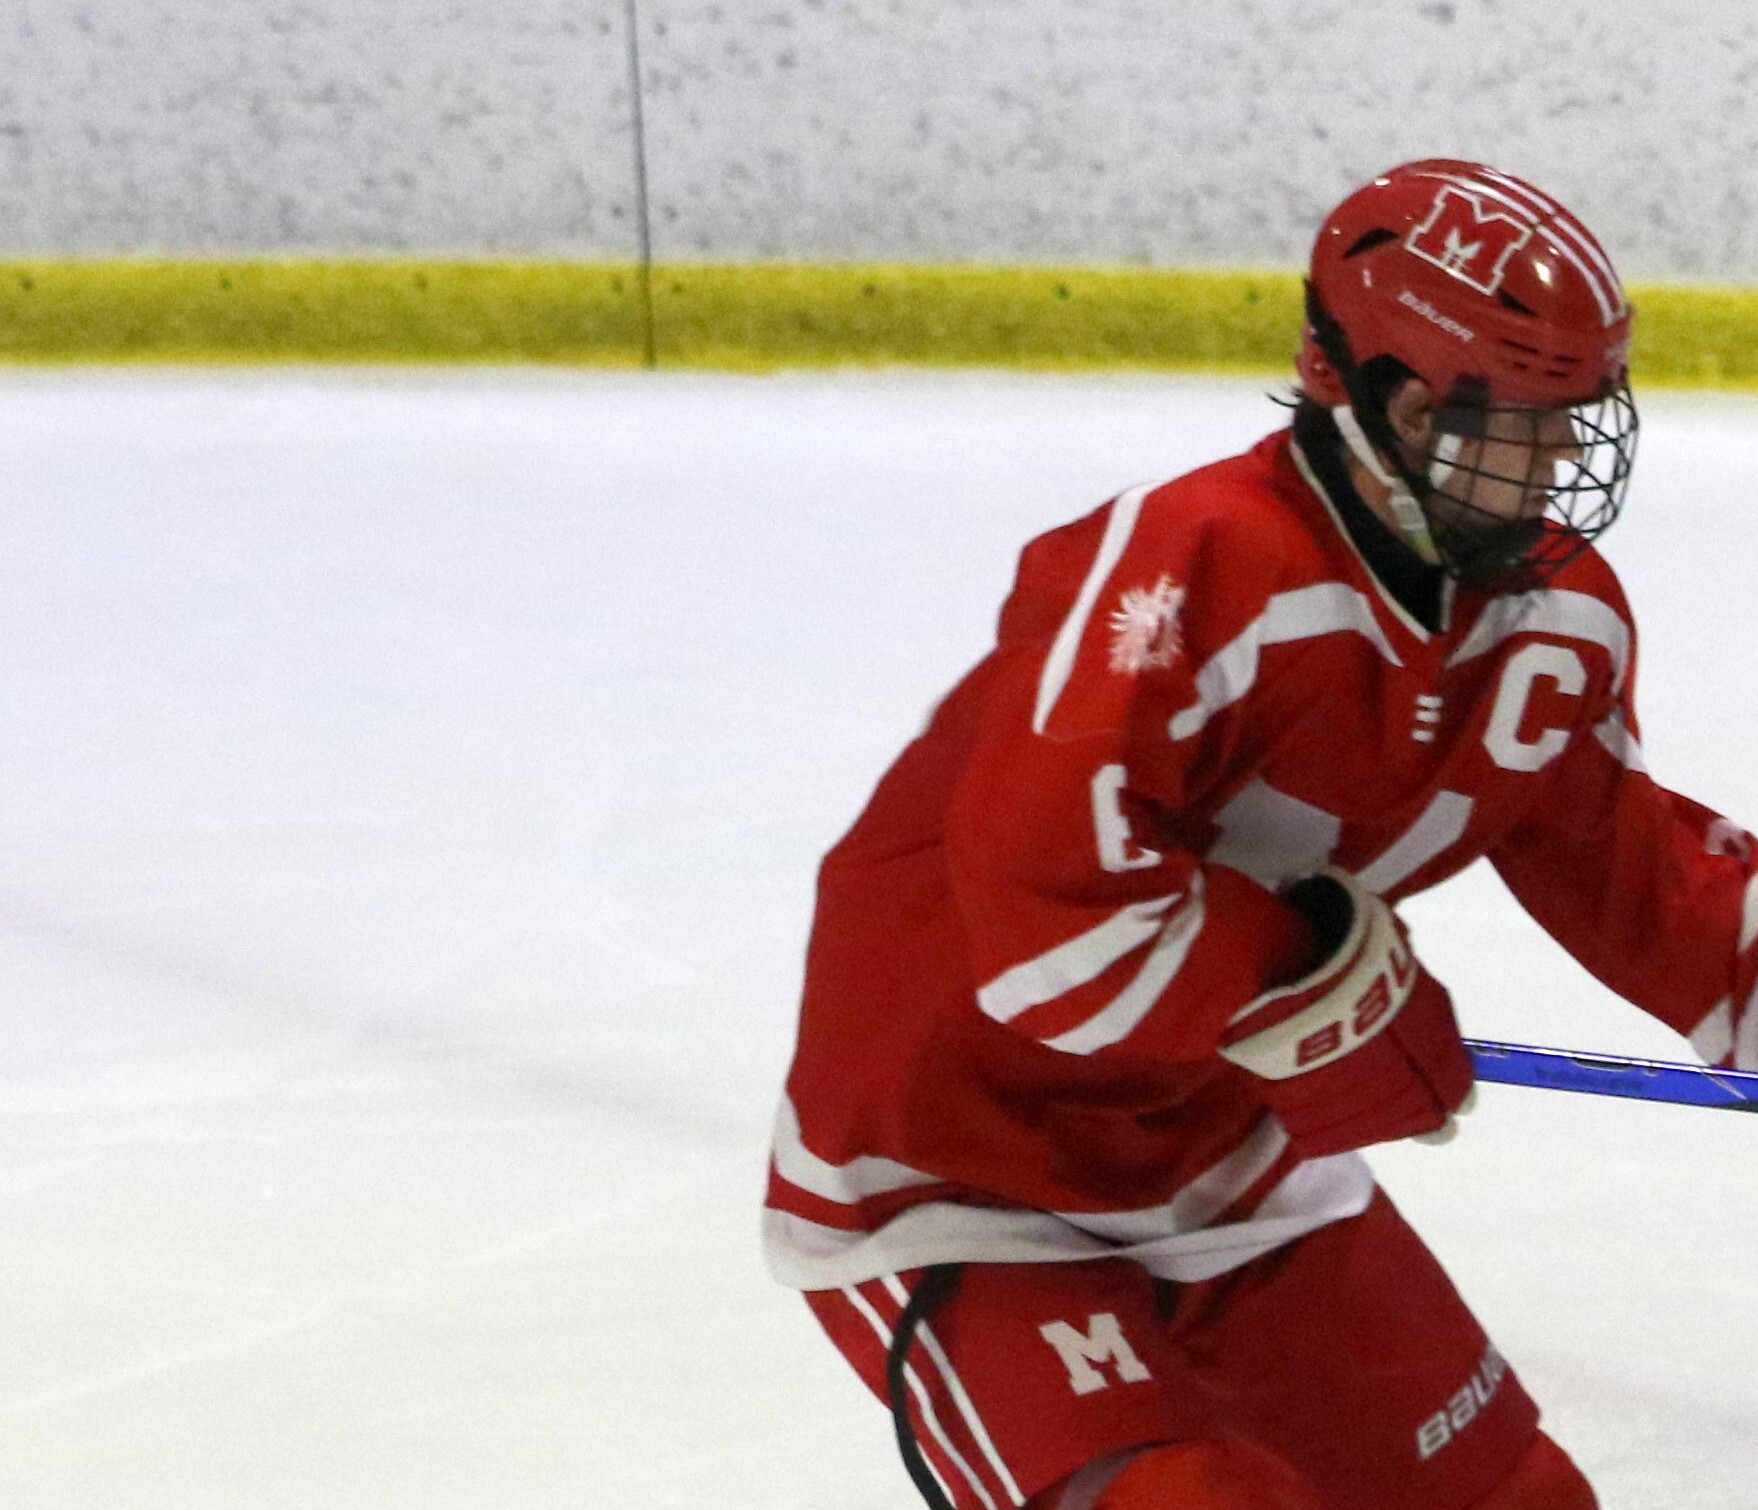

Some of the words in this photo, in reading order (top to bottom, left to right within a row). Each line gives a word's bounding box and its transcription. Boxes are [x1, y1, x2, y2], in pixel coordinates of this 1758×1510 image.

[1403, 184, 1533, 297] M
[1482, 642, 1589, 772] C
[1041, 1312, 1152, 1396] M
